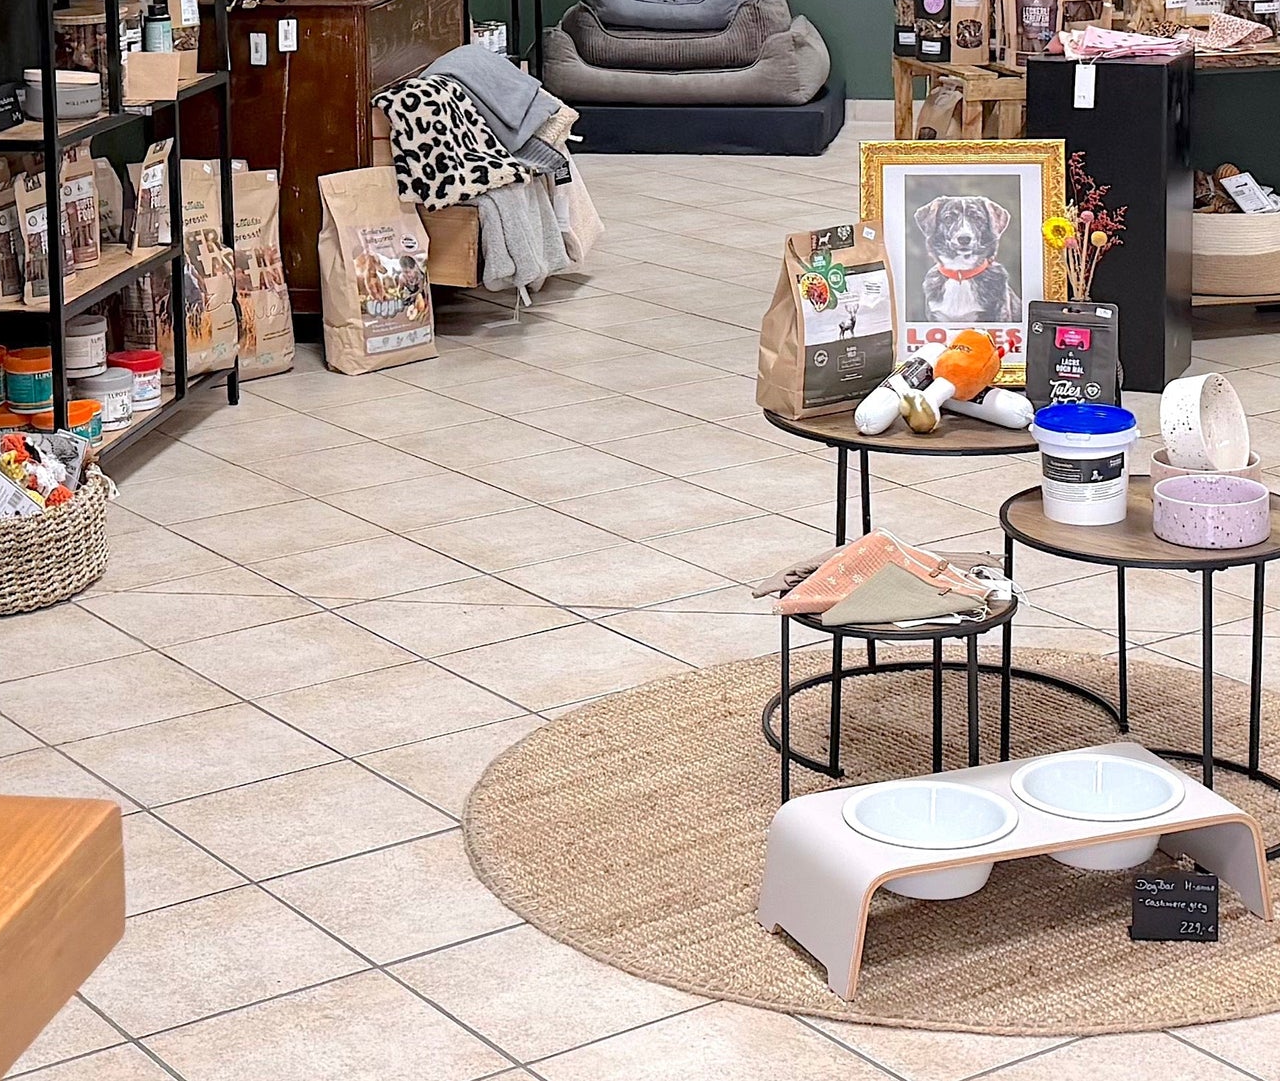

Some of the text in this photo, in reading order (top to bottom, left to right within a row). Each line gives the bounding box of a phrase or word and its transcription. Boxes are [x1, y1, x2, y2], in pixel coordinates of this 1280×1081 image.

[907, 328, 1023, 345] LOES
[1049, 379, 1083, 398] Tales
[1187, 902, 1208, 913] grey
